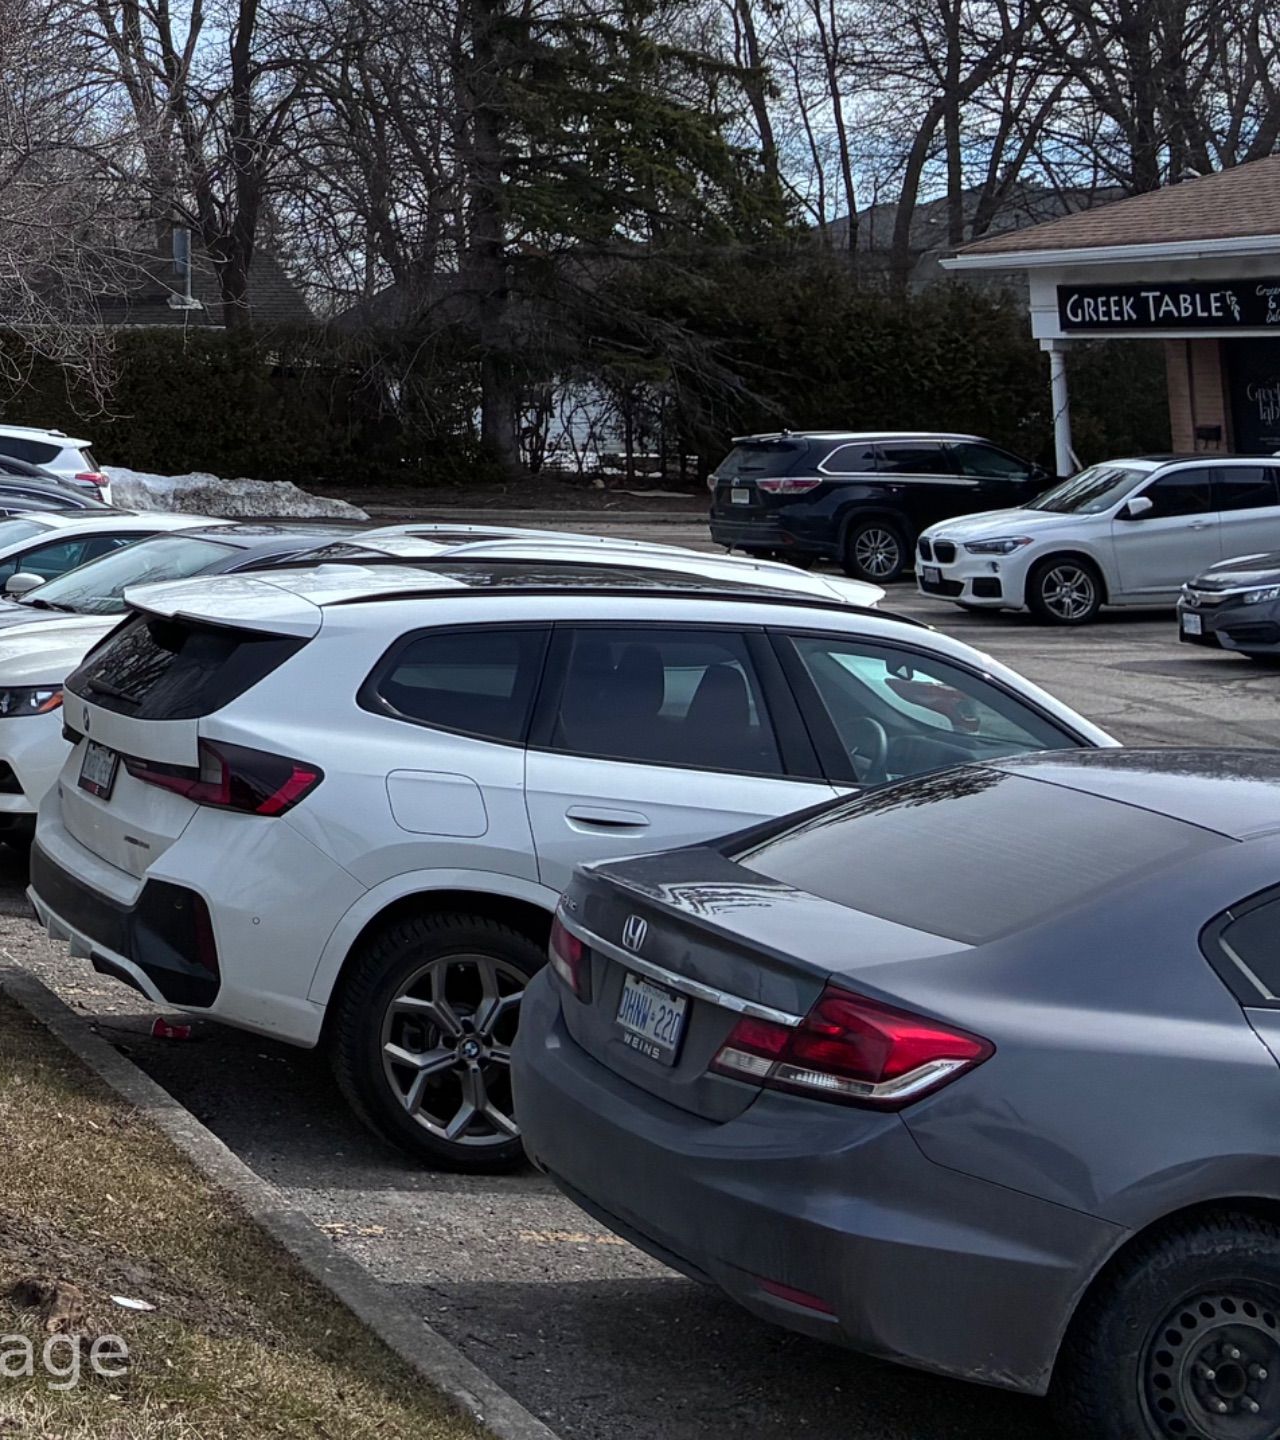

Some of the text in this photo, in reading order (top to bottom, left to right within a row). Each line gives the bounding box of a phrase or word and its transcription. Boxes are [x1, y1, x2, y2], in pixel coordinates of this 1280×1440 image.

[1066, 291, 1223, 323] GREEK TABLE
[623, 1032, 660, 1059] WEINS
